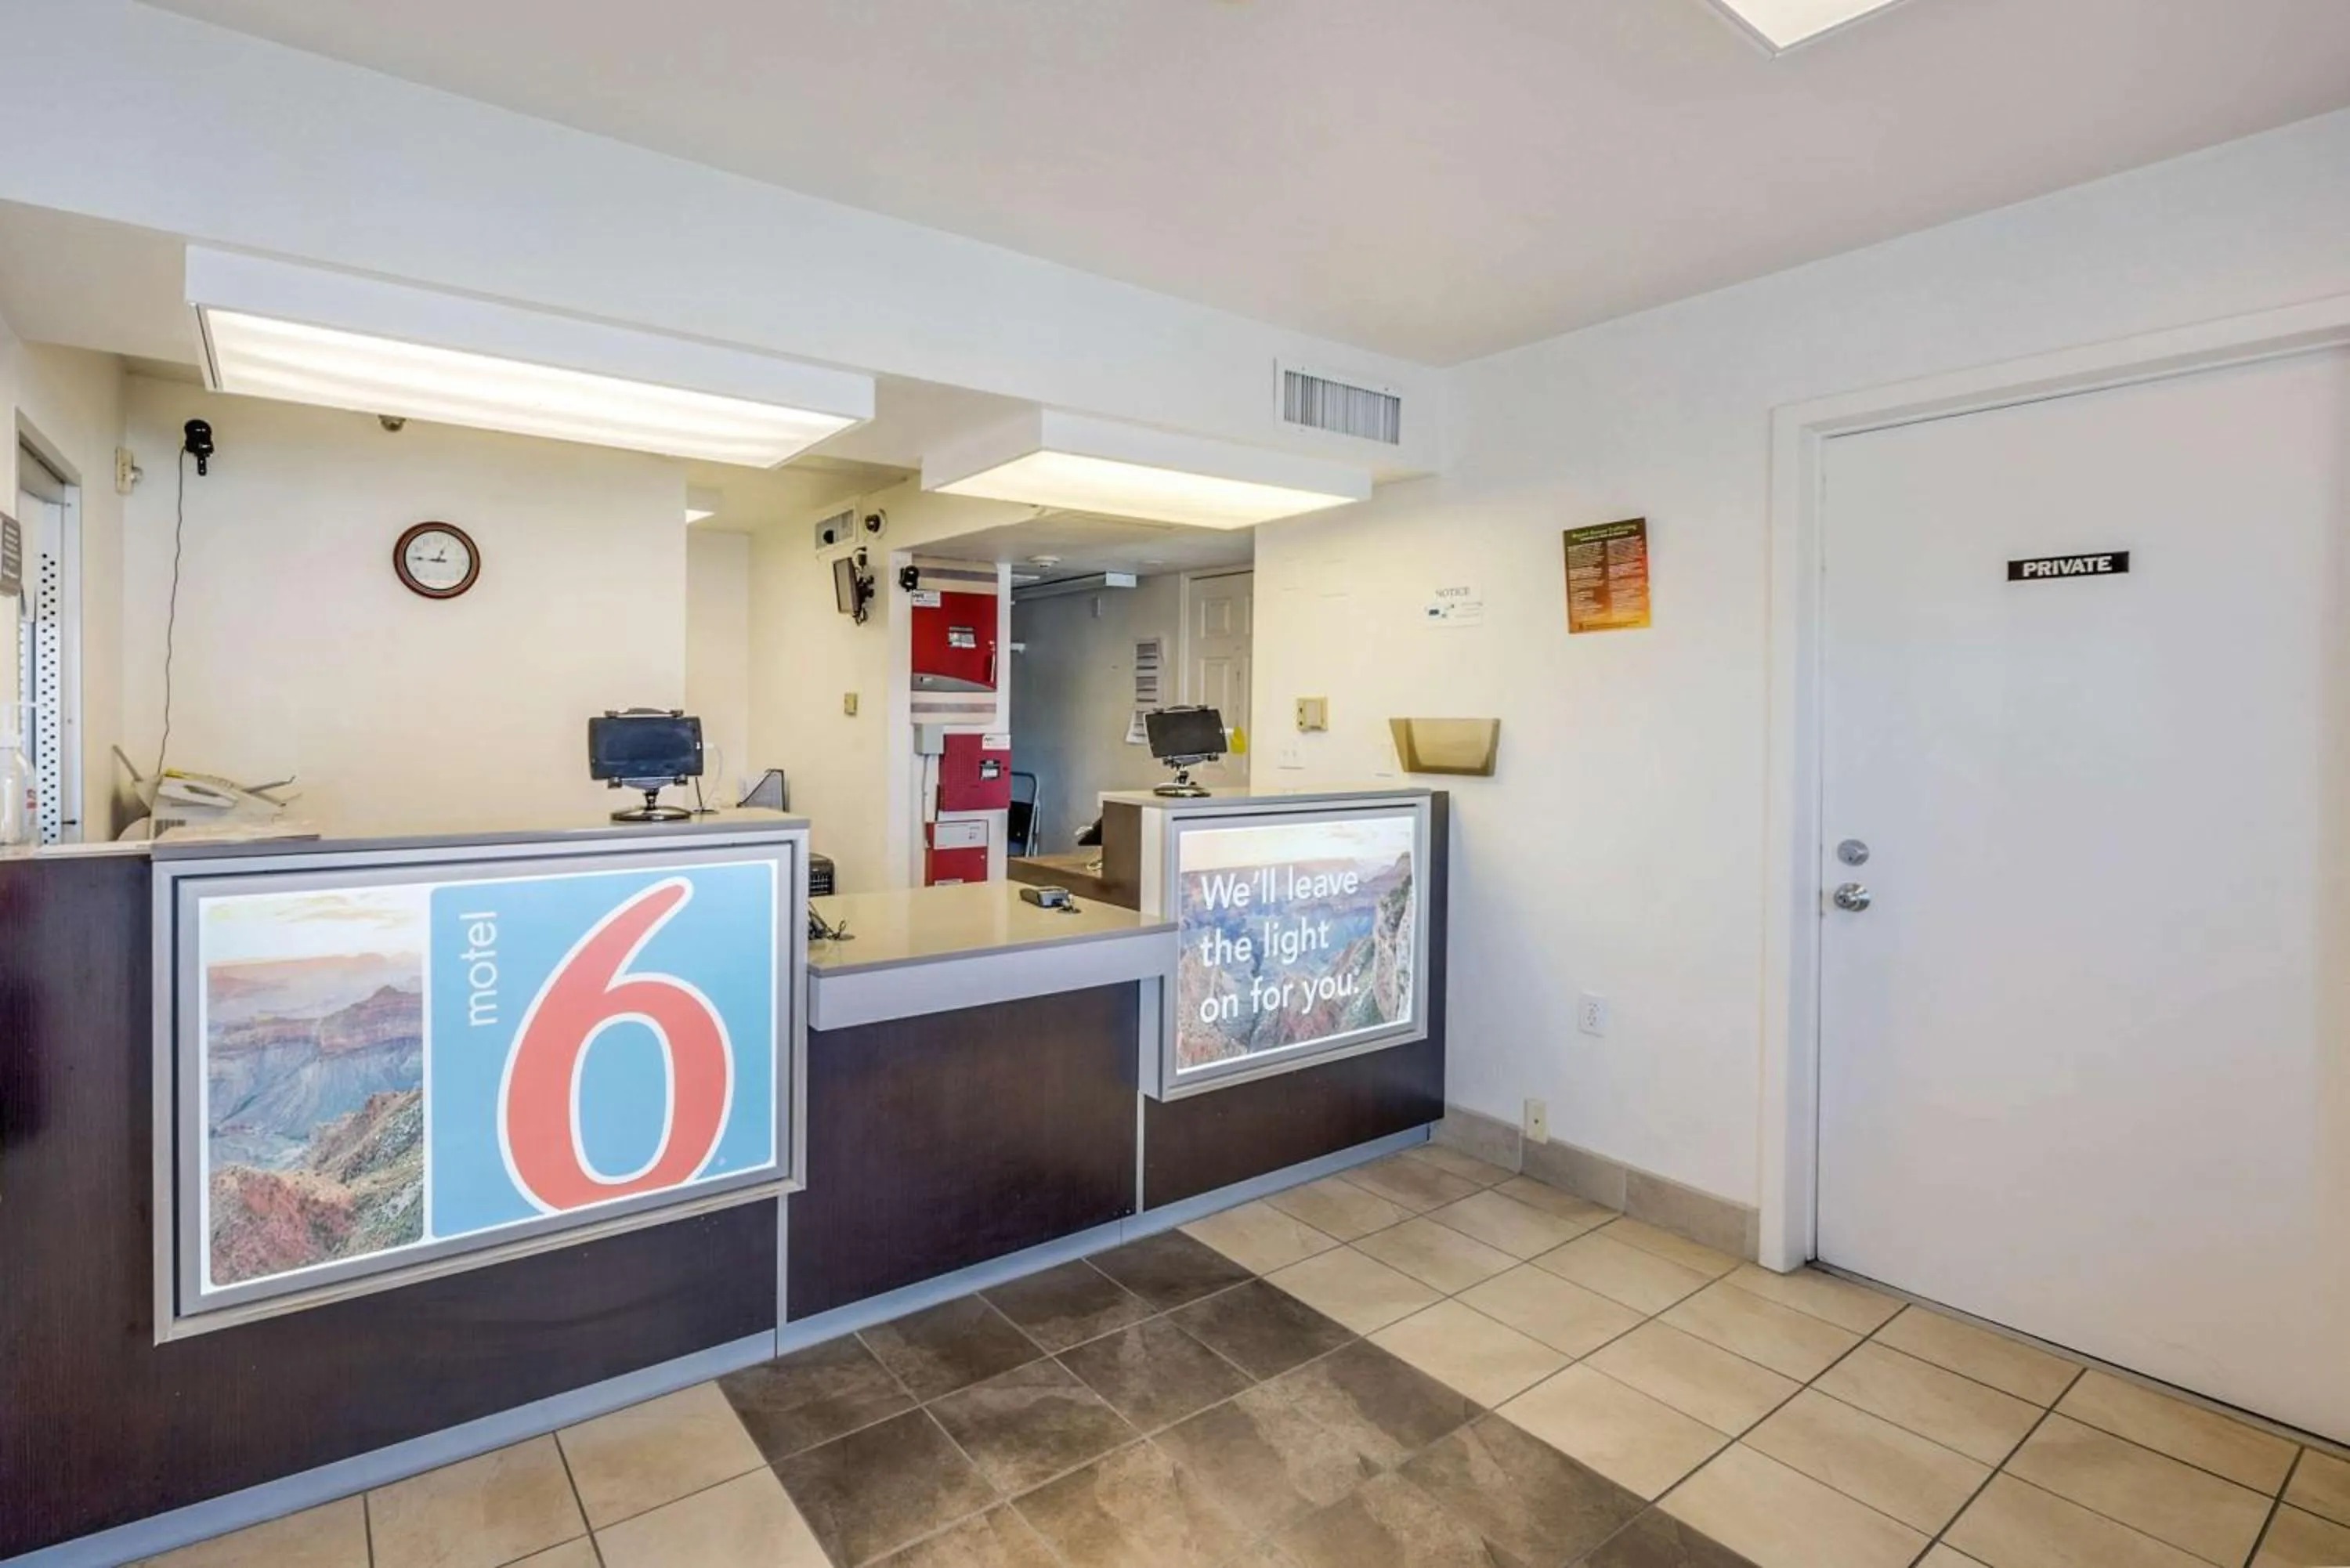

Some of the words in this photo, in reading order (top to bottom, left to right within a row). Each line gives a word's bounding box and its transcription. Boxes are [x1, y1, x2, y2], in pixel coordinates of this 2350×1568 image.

[2023, 555, 2113, 577] PRIVATE
[1435, 586, 1470, 597] NOTICE
[1201, 866, 1276, 911] We'll
[1288, 865, 1359, 901] leave
[1200, 927, 1252, 968] the
[1264, 916, 1330, 965] light
[1199, 992, 1238, 1023] on
[1250, 975, 1294, 1014] for
[459, 911, 498, 1026] motel
[497, 876, 736, 1216] 6
